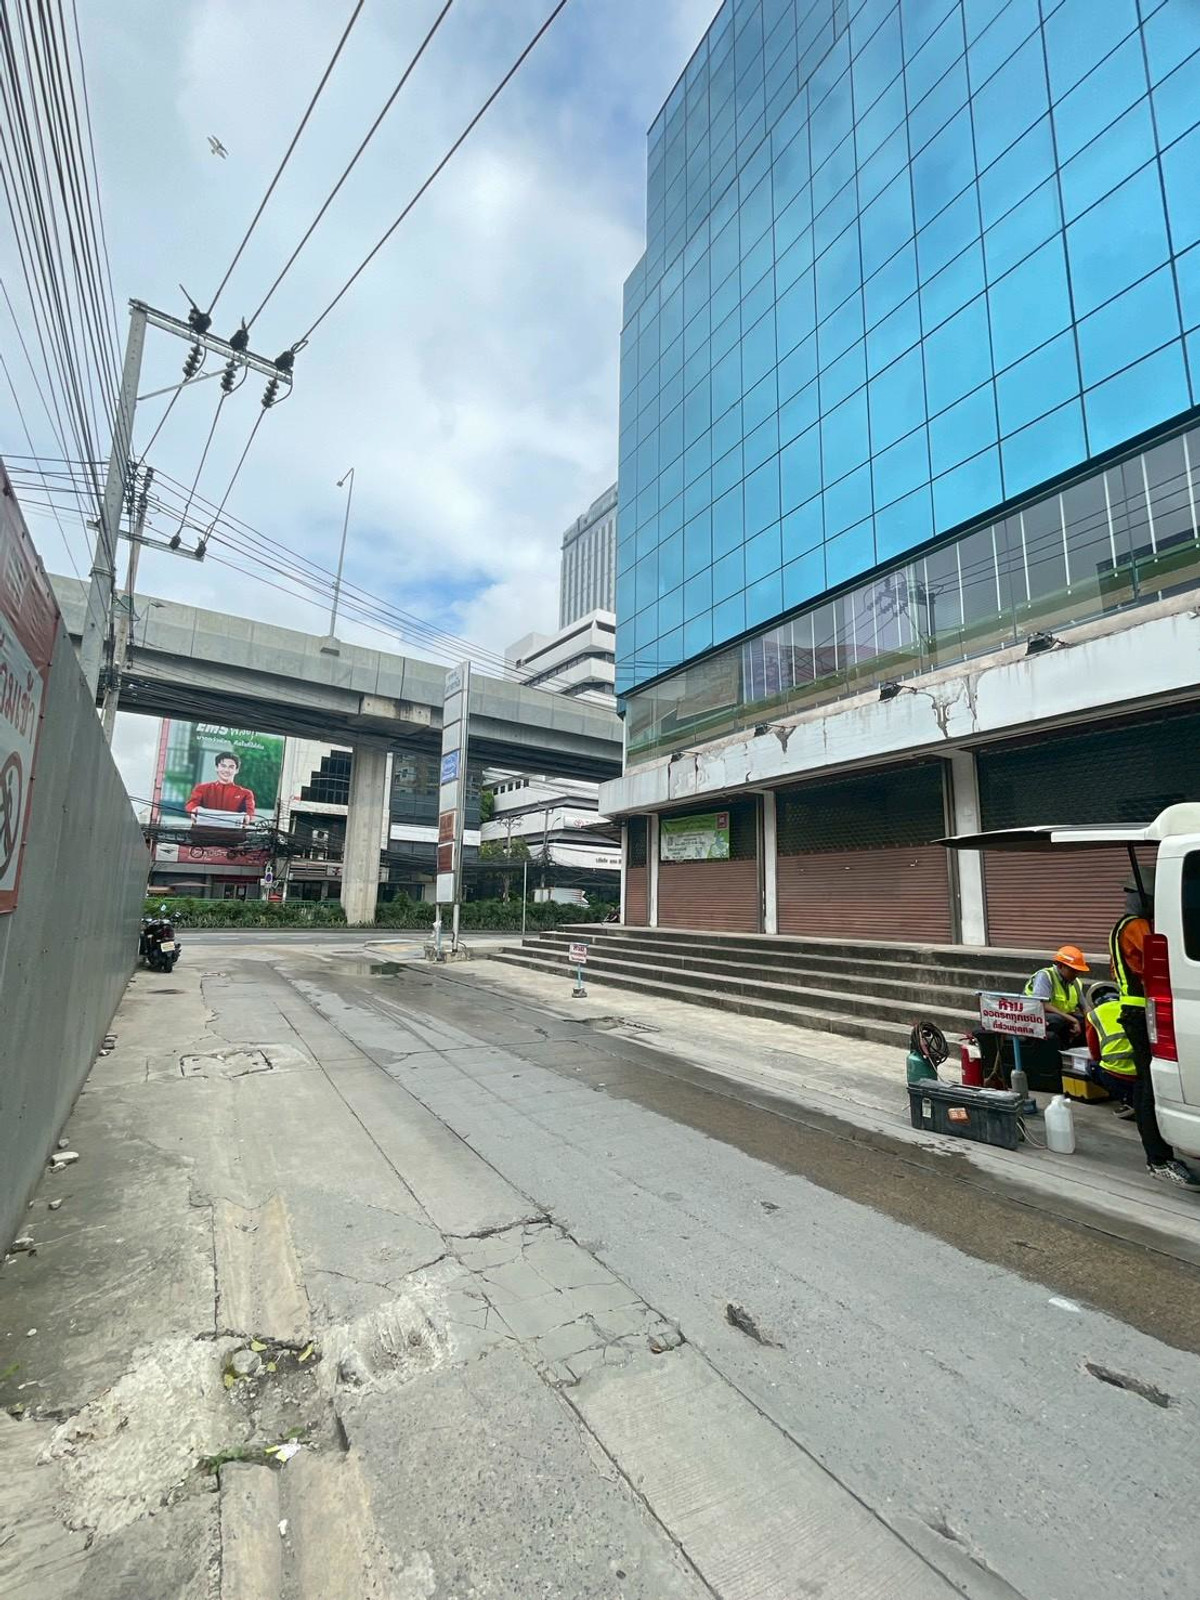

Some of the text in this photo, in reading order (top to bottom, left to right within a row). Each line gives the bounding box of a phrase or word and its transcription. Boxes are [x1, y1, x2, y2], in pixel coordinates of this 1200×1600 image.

[998, 998, 1024, 1012] ห้าม
[983, 1009, 1043, 1025] จอดรถทุกชนิด
